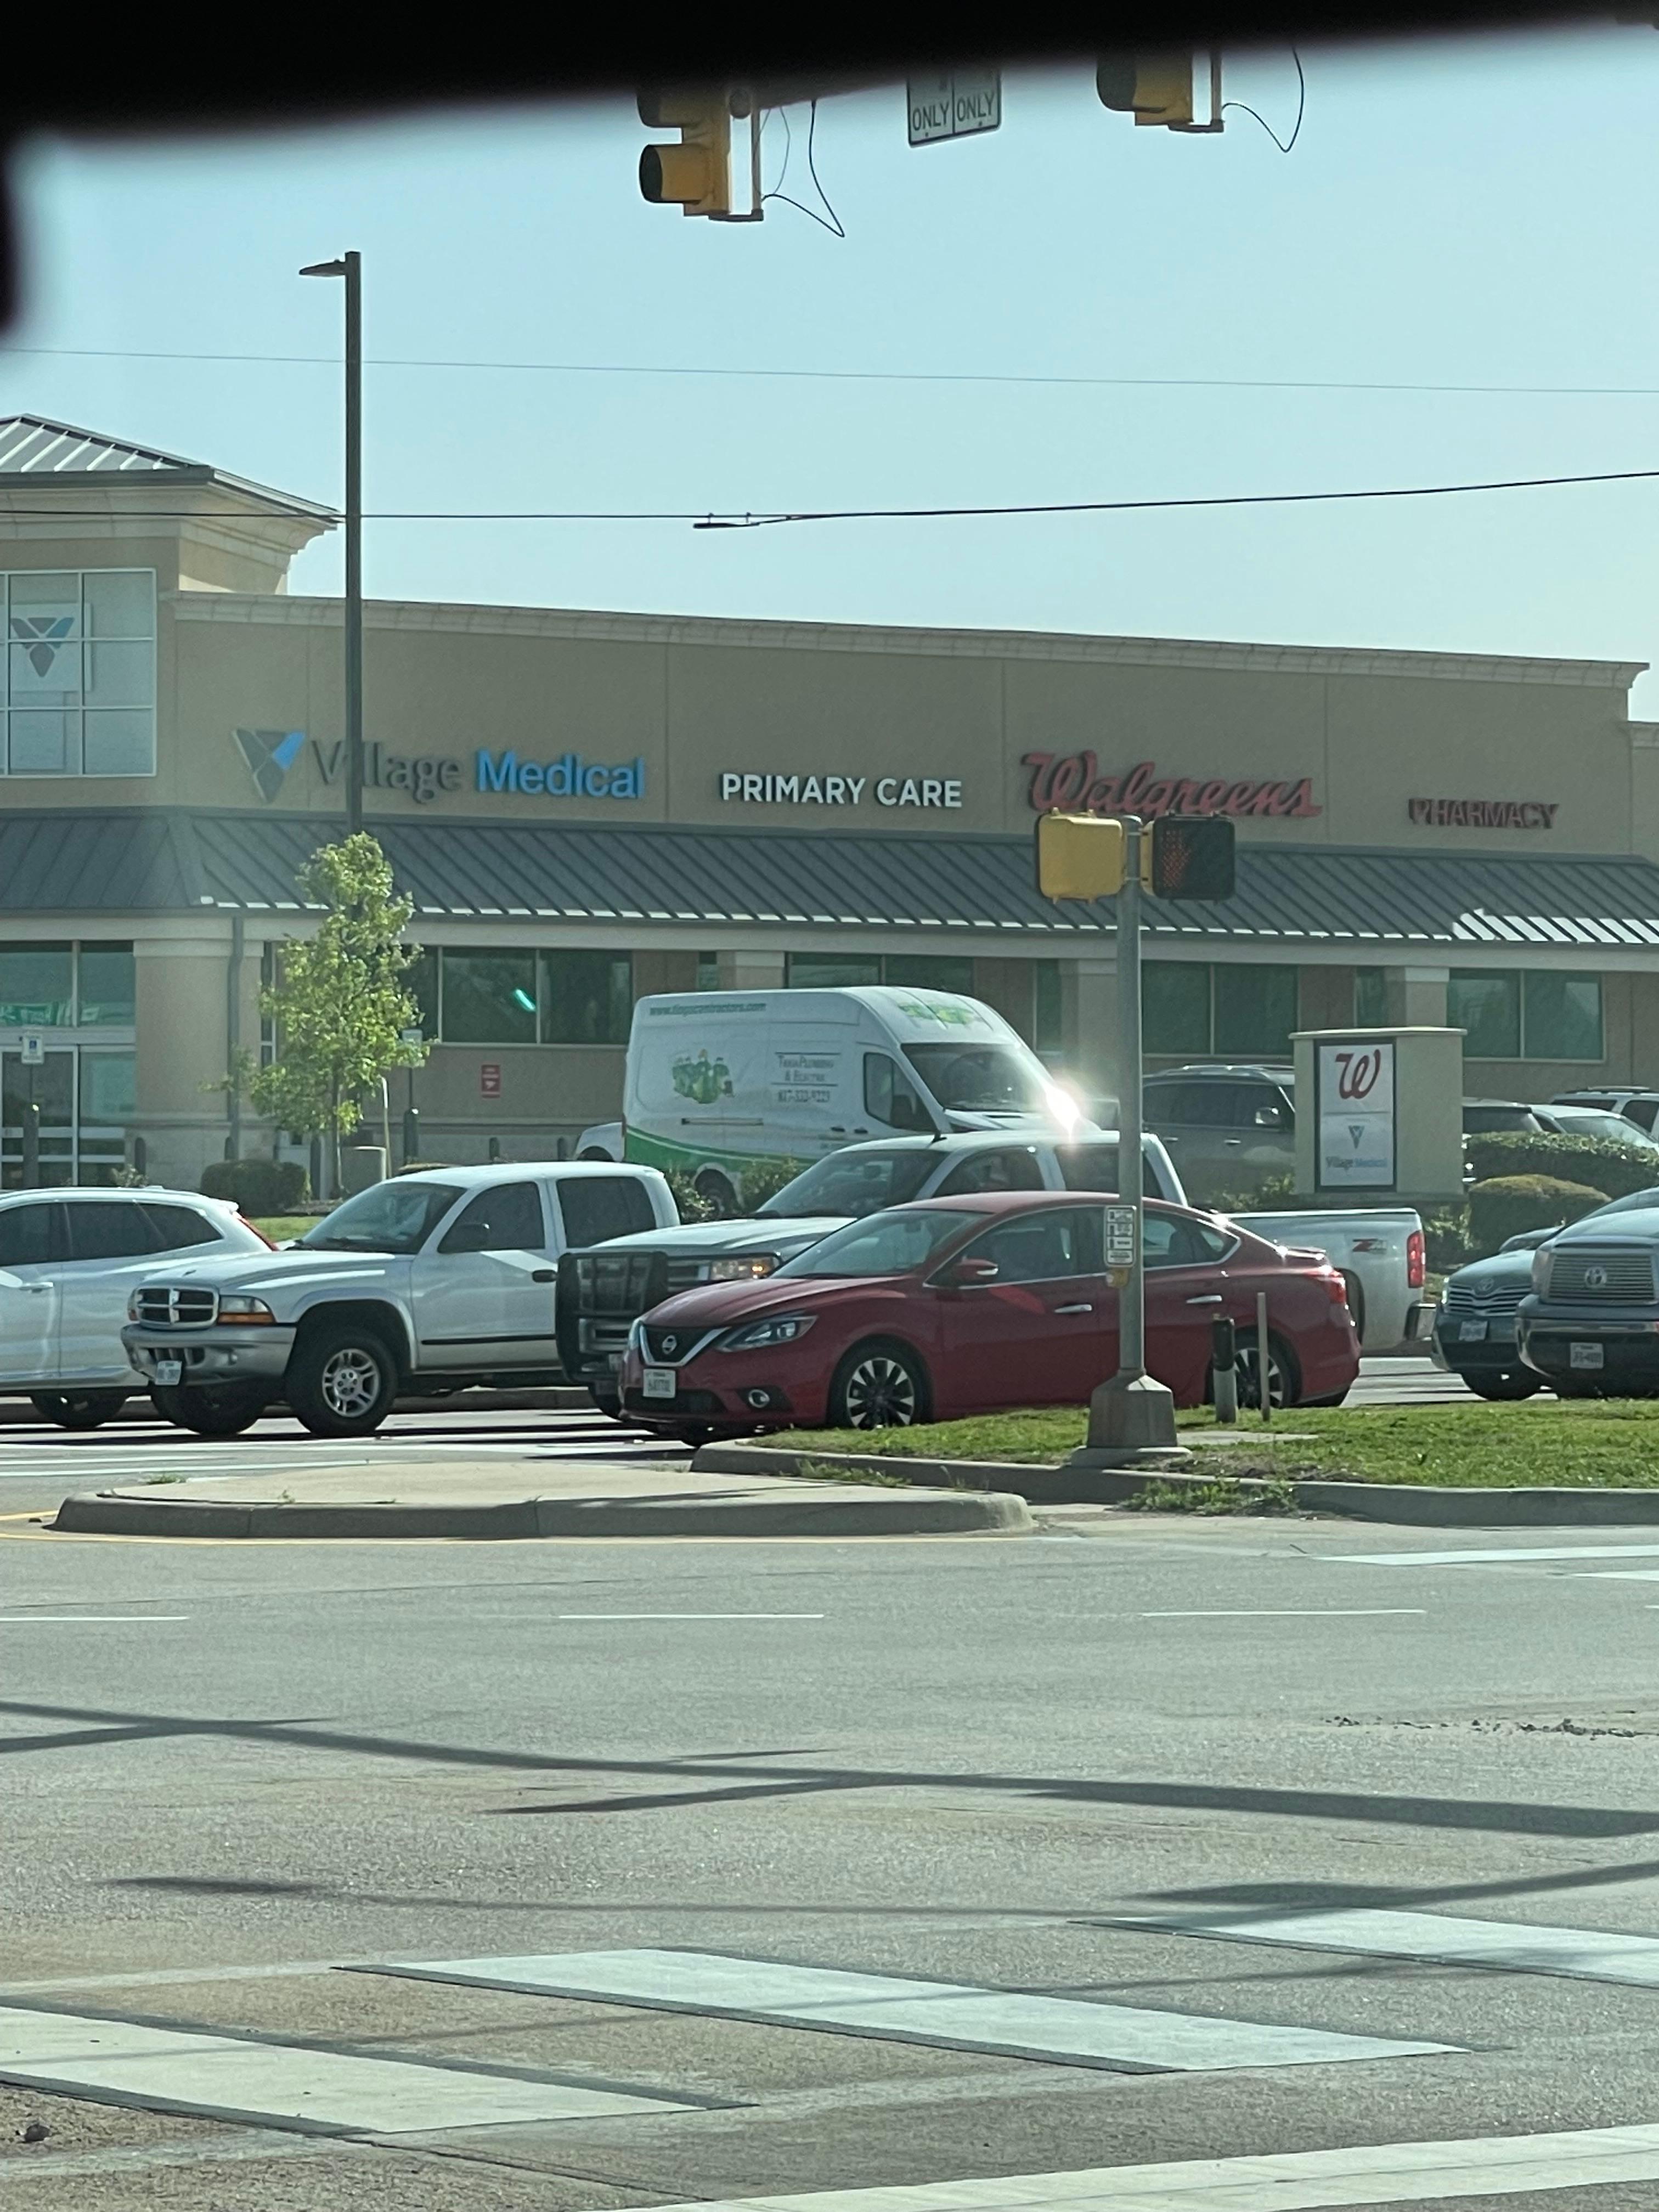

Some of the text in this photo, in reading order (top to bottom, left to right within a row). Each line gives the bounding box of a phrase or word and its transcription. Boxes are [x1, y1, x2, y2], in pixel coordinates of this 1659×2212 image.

[912, 91, 995, 131] ONLY ONLY
[311, 740, 646, 803] Vllage Medical
[720, 773, 962, 808] PRIMARY CARE
[1021, 750, 1323, 817] Walgreens
[1408, 798, 1559, 828] PHARMACY
[1335, 1049, 1381, 1099] W
